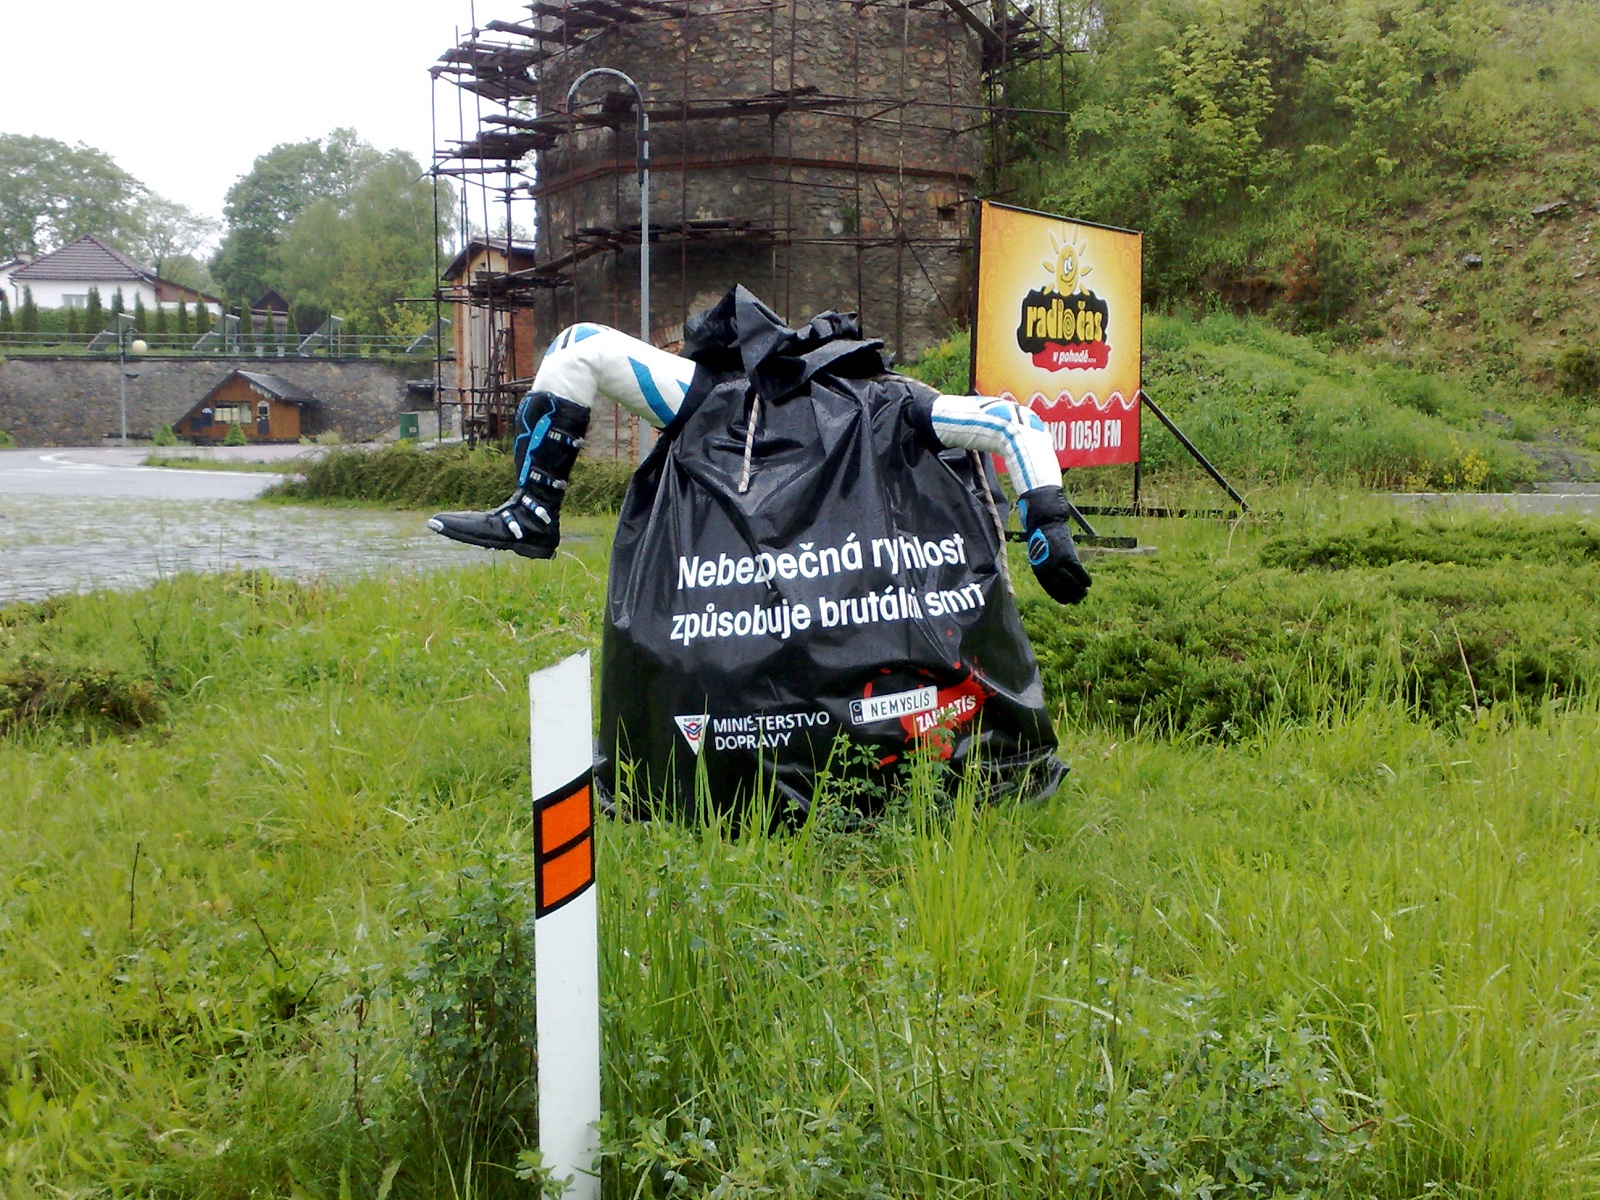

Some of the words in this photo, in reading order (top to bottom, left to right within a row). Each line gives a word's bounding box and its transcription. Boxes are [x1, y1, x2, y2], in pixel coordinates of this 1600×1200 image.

[1027, 298, 1075, 340] radio
[1076, 300, 1103, 342] čas
[1044, 420, 1067, 451] KO
[1070, 419, 1102, 452] 105,9
[1104, 419, 1122, 448] FM
[677, 532, 864, 590] Nebepečná
[871, 532, 967, 575] ryhlost
[670, 599, 812, 647] způsobuje
[924, 582, 986, 617] smrt
[870, 690, 931, 718] NEMYSLÍŠ
[713, 711, 830, 734] MINISTERSTVO
[714, 732, 792, 751] DOPRAVY
